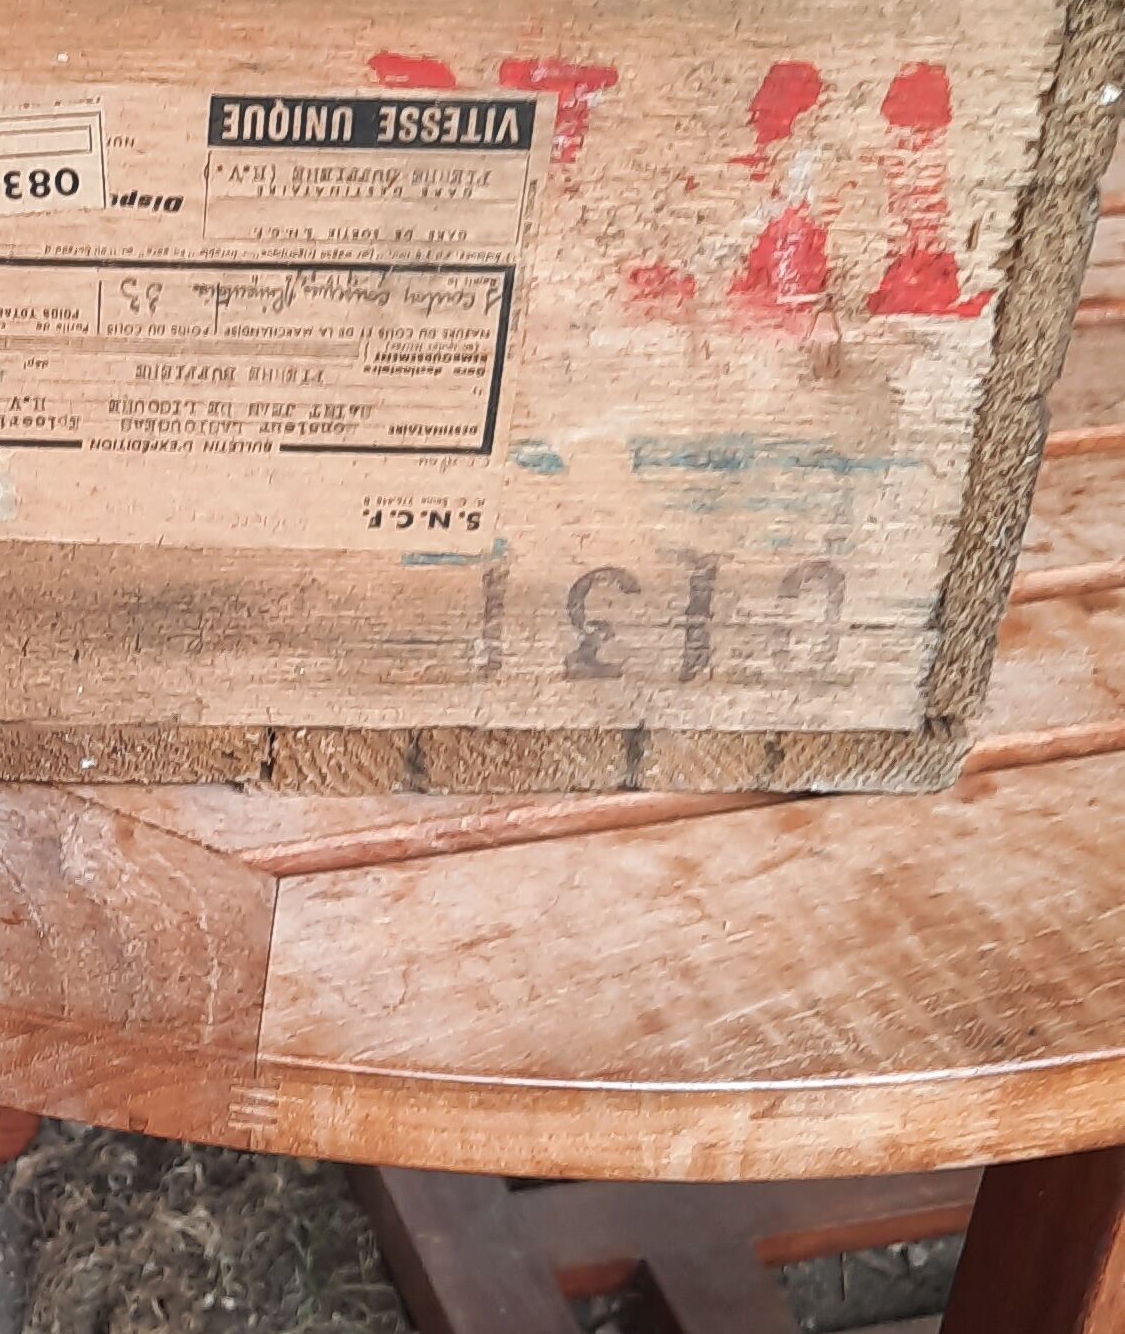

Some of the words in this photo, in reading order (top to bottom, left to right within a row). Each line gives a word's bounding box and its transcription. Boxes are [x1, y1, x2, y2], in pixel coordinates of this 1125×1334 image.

[220, 99, 353, 142] UNIQUE
[376, 105, 519, 144] VITESSE
[394, 228, 414, 242] DE
[428, 229, 468, 242] GARE
[42, 308, 80, 321] POIDS
[106, 323, 142, 336] COLIS
[147, 324, 165, 336] DU
[171, 324, 210, 337] POIDS
[223, 324, 313, 338] MARCHANDISE
[377, 327, 413, 340] COLIS
[443, 328, 490, 340] NATURE
[208, 400, 233, 417] DE
[248, 402, 296, 418] JEAN
[387, 424, 478, 436] DESTINATAIRE
[89, 438, 194, 454] D'EXPÉDITION
[203, 440, 273, 455] BULLETIN
